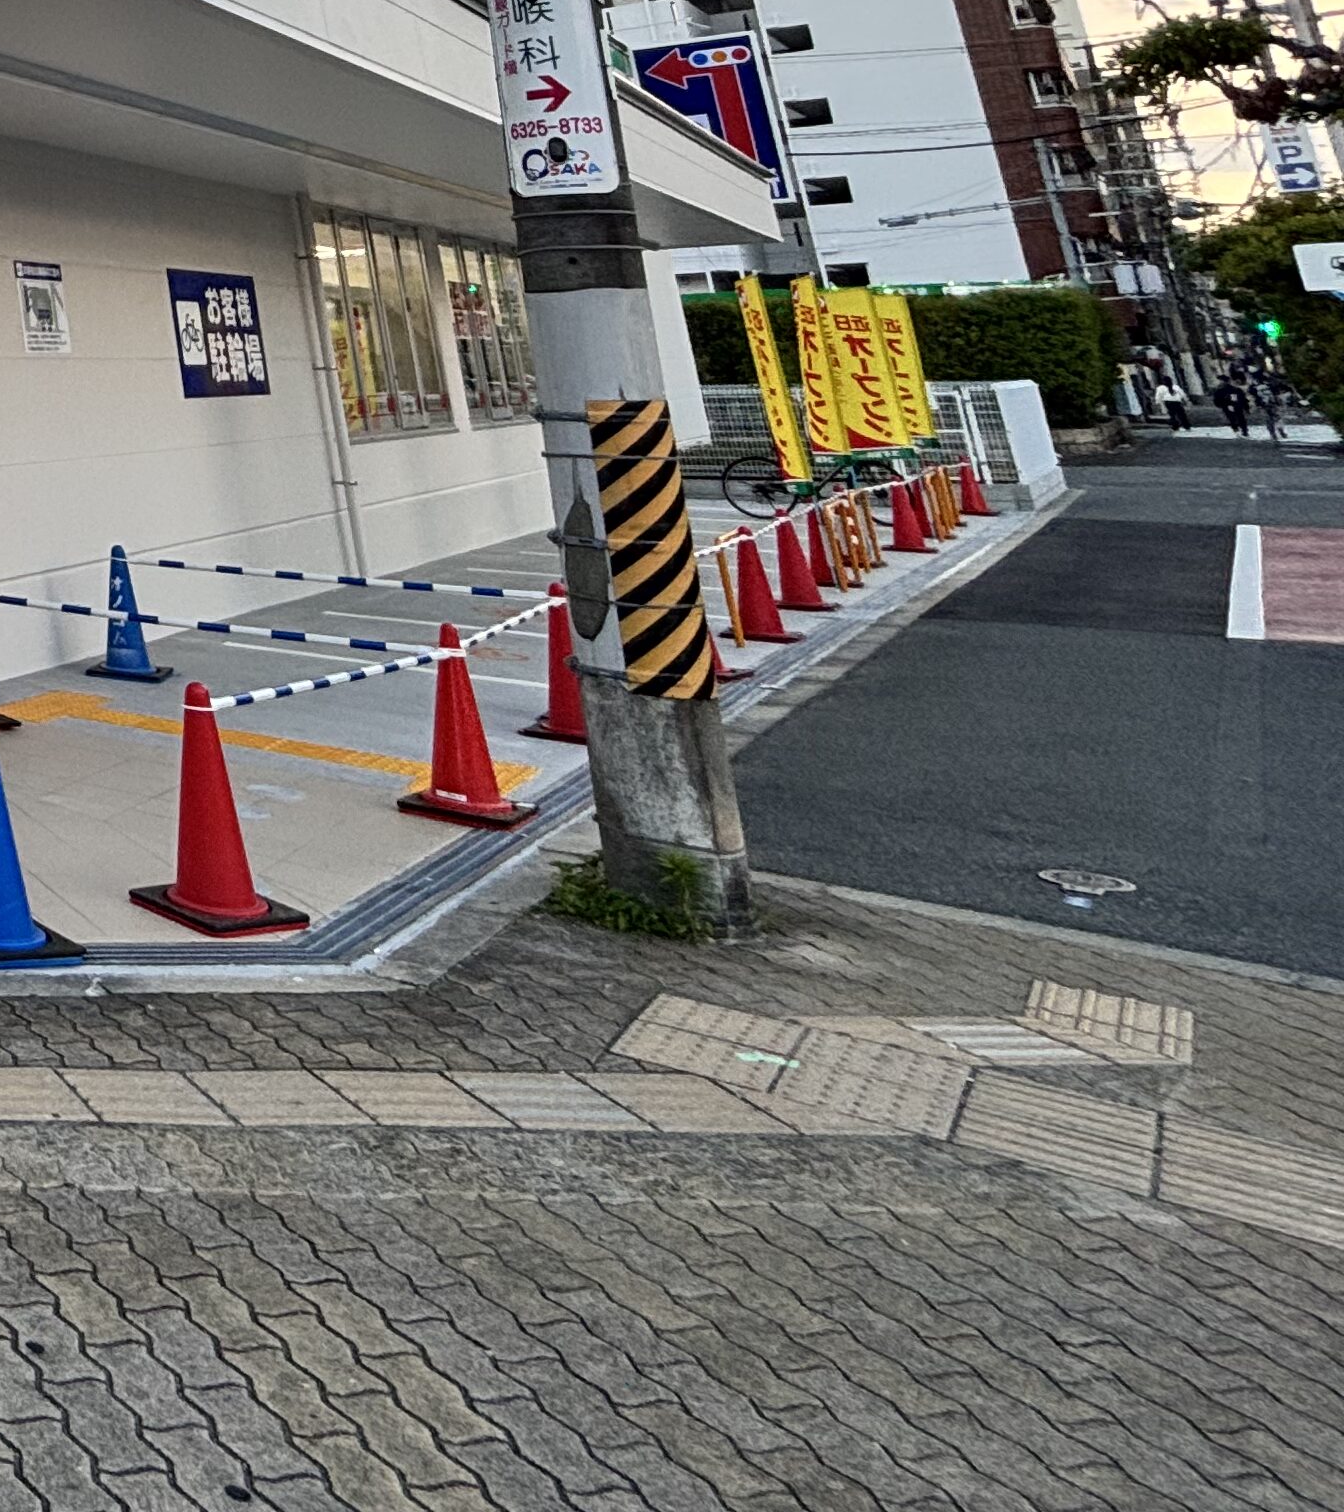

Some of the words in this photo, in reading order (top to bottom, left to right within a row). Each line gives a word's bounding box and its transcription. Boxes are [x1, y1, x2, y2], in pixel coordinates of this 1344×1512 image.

[511, 117, 603, 140] 6325-8733
[205, 287, 253, 328] お客様
[207, 332, 265, 382] 駐輪場
